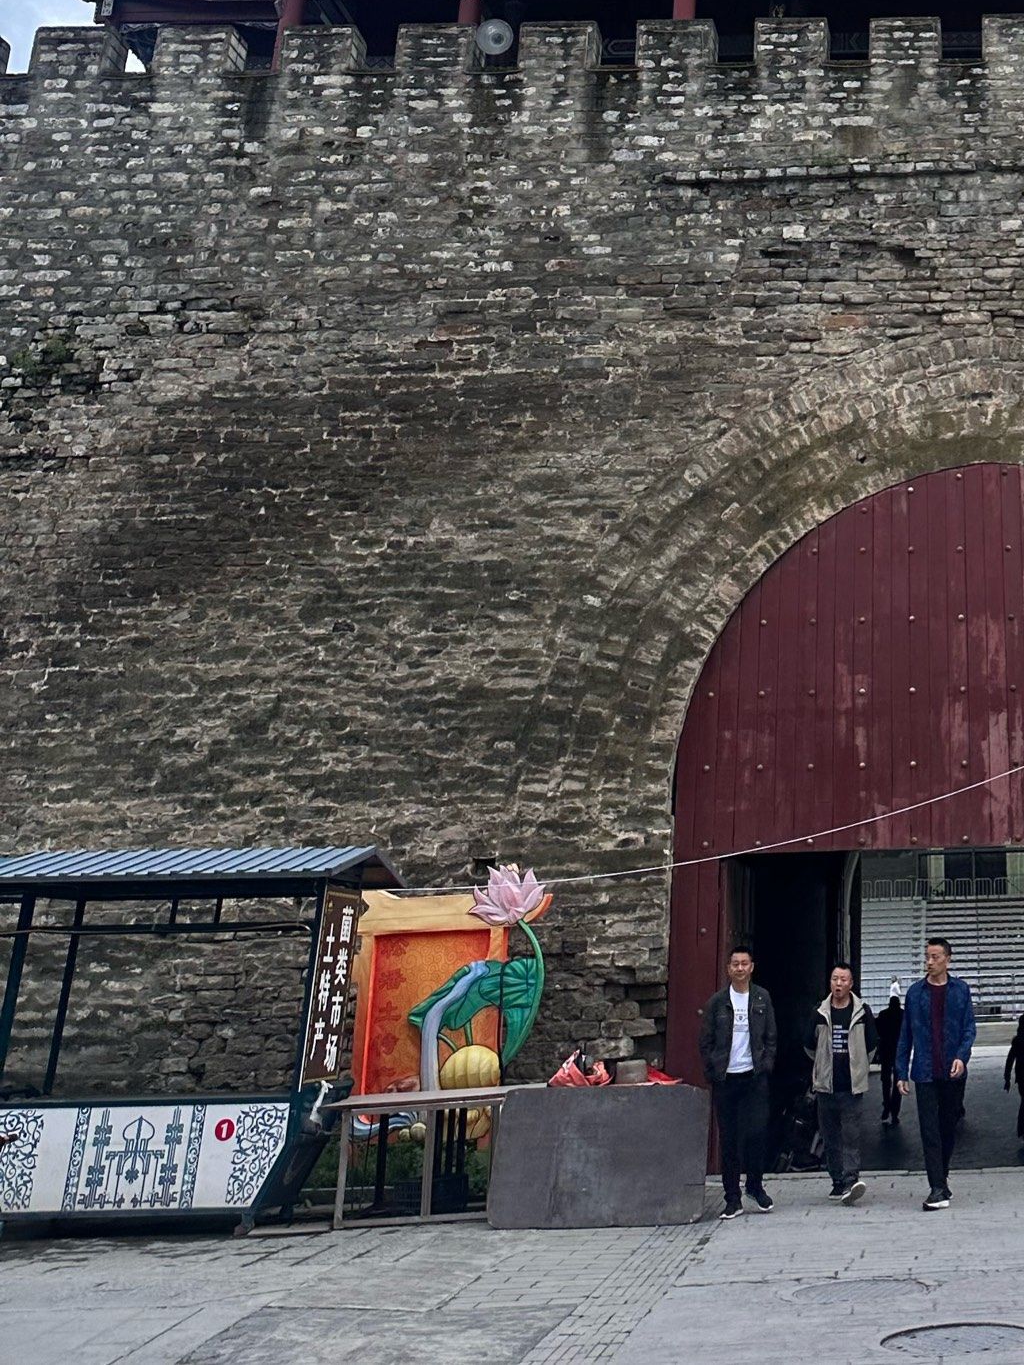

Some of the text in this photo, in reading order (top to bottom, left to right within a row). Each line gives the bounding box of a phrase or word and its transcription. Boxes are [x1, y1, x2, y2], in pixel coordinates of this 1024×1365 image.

[309, 922, 335, 1061] 土特产
[323, 905, 355, 1073] 菌类市场
[220, 1121, 229, 1139] 1
